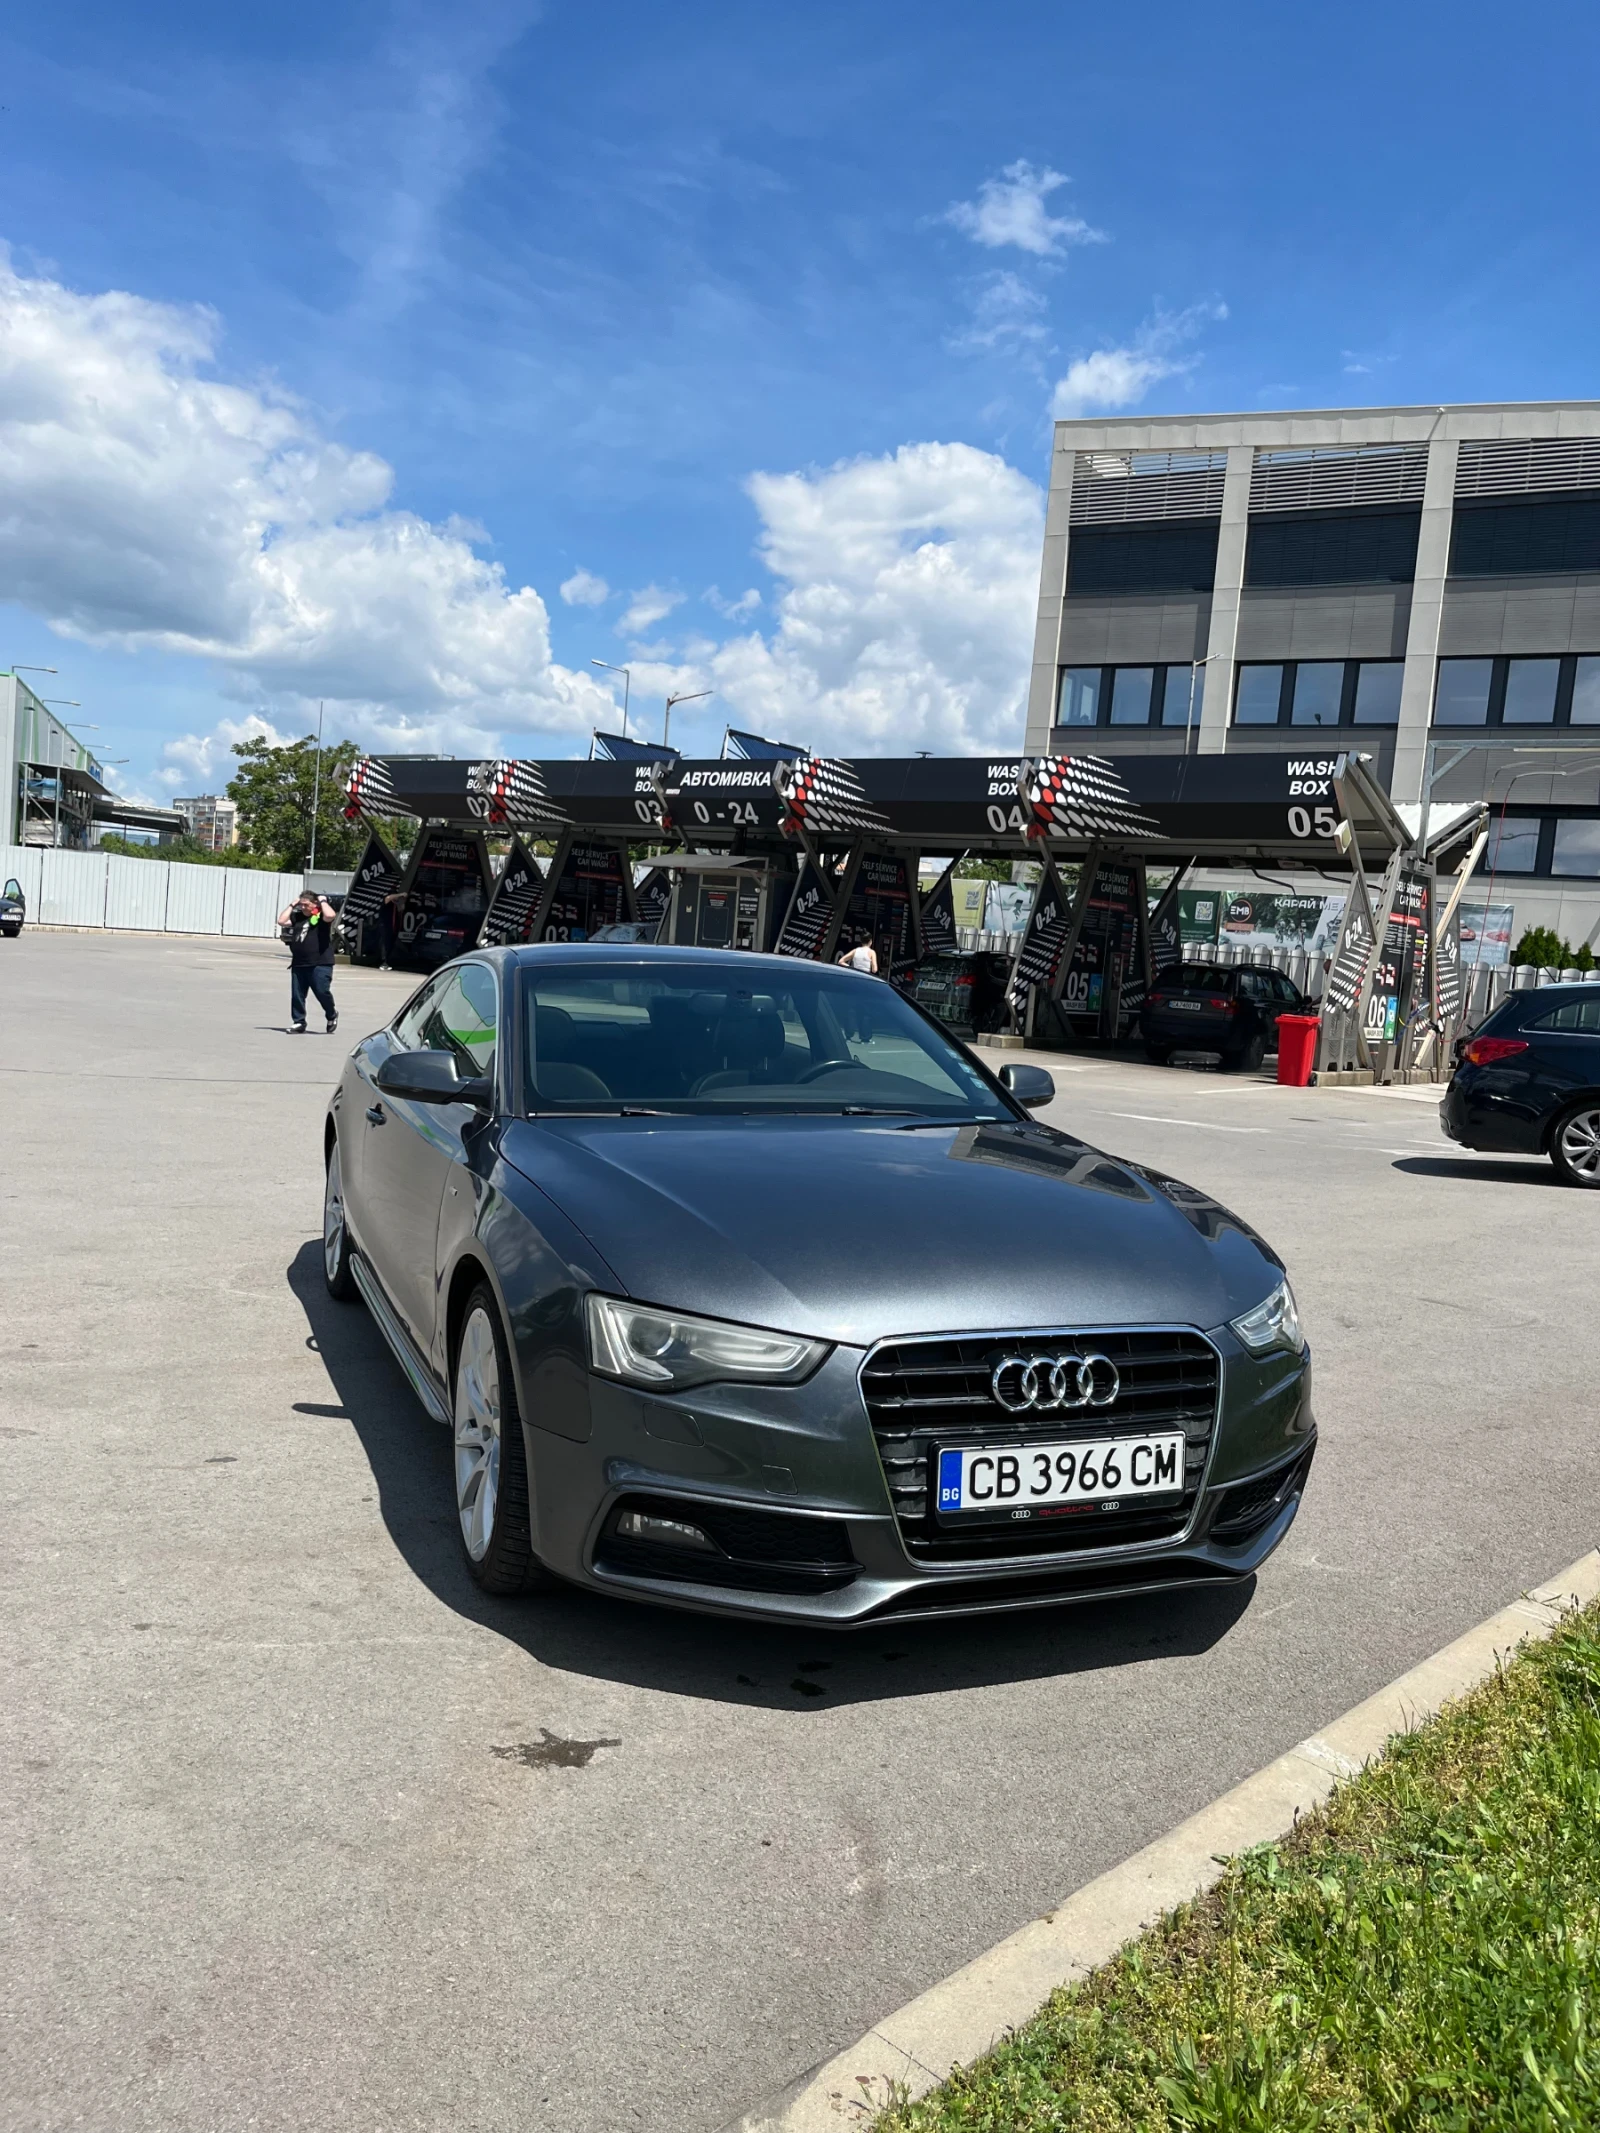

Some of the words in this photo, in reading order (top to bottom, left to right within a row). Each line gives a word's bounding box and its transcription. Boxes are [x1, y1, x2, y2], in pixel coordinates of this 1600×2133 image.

[680, 771, 771, 787] АВТОМИВКА
[988, 765, 1020, 778] WAS
[988, 782, 1019, 796] BOX
[1289, 780, 1331, 796] BOX
[987, 805, 1025, 834] 04
[1287, 806, 1338, 838] 05
[362, 861, 385, 882] 0-24
[862, 860, 875, 871] SELF
[875, 862, 898, 873] SERVICE
[504, 870, 528, 893] 0-24
[867, 871, 879, 881] CAR
[879, 873, 897, 884] WASH
[1096, 870, 1108, 881] SELF
[1108, 872, 1129, 885] SERVICE
[1101, 883, 1112, 893] CAR
[1112, 884, 1128, 896] WASH
[796, 887, 819, 914] 0-24
[1274, 898, 1317, 909] КАРАЙ
[934, 904, 952, 930] 0-24
[1036, 901, 1057, 931] 0-24
[1230, 906, 1250, 915] EMB
[1161, 918, 1177, 945] 0-24
[1345, 915, 1363, 950] 0-24
[1067, 971, 1089, 1001] 05
[1368, 995, 1387, 1028] 06
[969, 1455, 1021, 1501] CB
[1030, 1448, 1122, 1496] 3966
[1130, 1442, 1177, 1487] CM
[942, 1488, 960, 1502] BG
[1039, 1504, 1095, 1516] quattro
